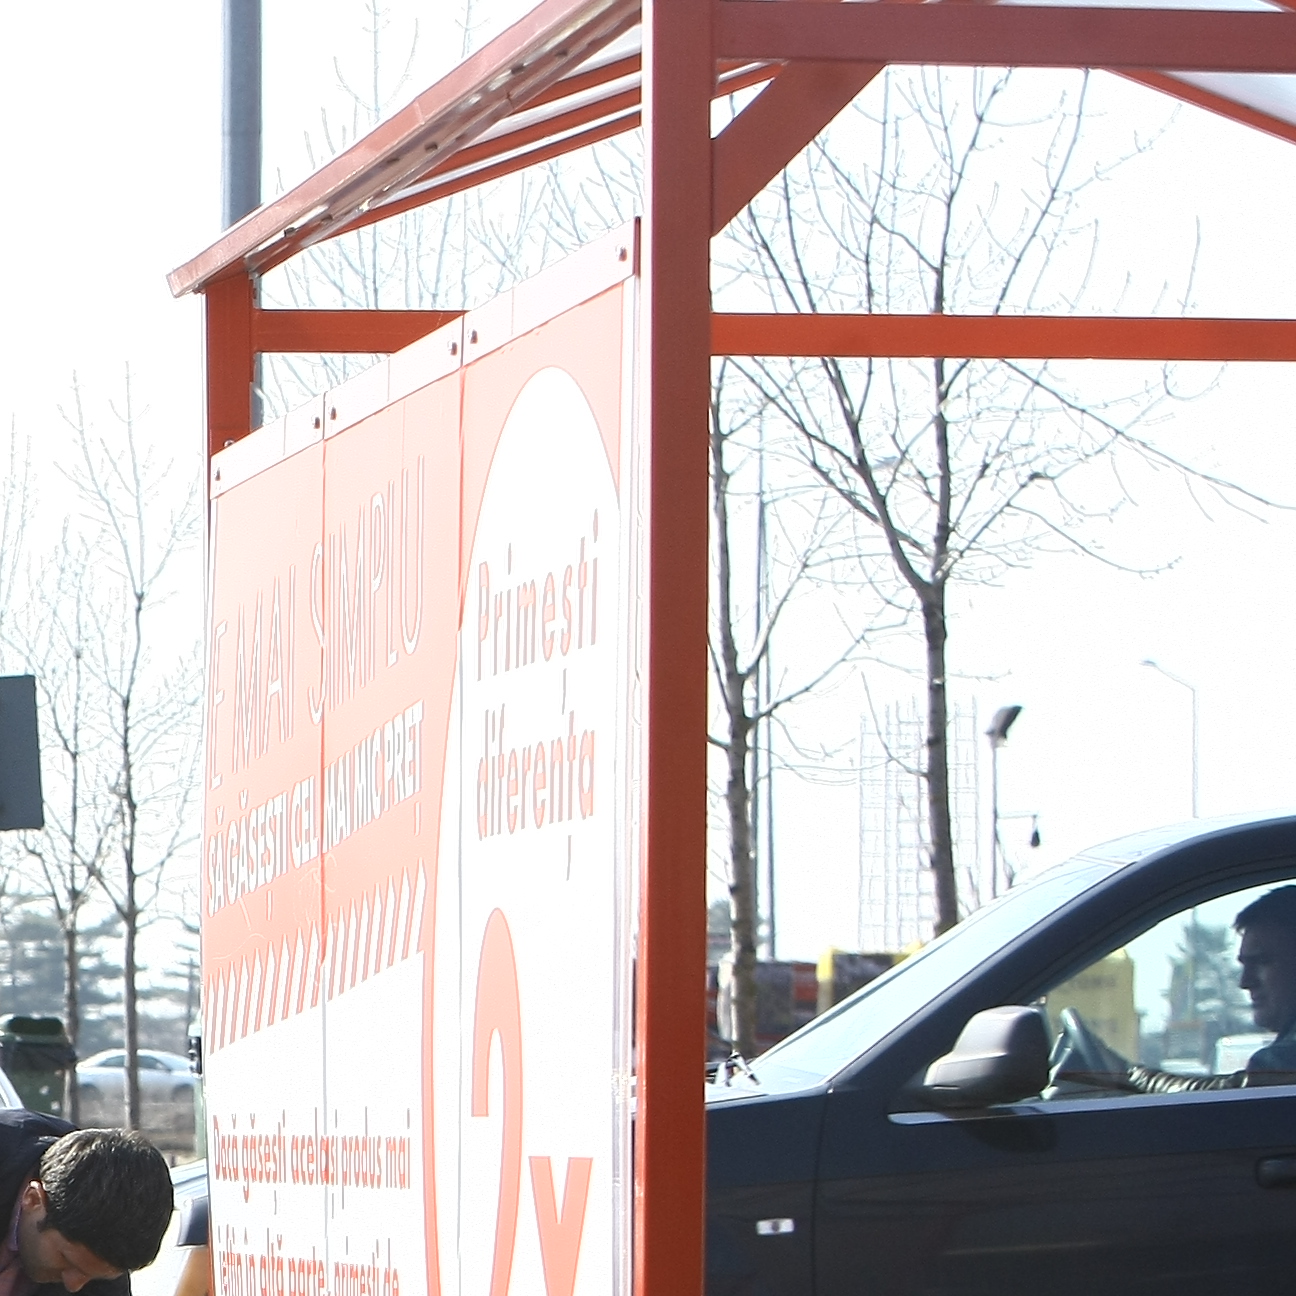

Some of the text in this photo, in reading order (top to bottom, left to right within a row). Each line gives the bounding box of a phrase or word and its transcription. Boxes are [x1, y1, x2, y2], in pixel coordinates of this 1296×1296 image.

[232, 563, 296, 773] MAI
[307, 454, 425, 726] SIMPLU
[290, 774, 319, 870] CEL
[322, 751, 352, 854] MAI
[353, 728, 382, 831] MIC
[475, 703, 596, 882] diferența
[212, 1112, 239, 1182] Dacă
[341, 1105, 383, 1210] produs
[385, 1107, 412, 1189] mai
